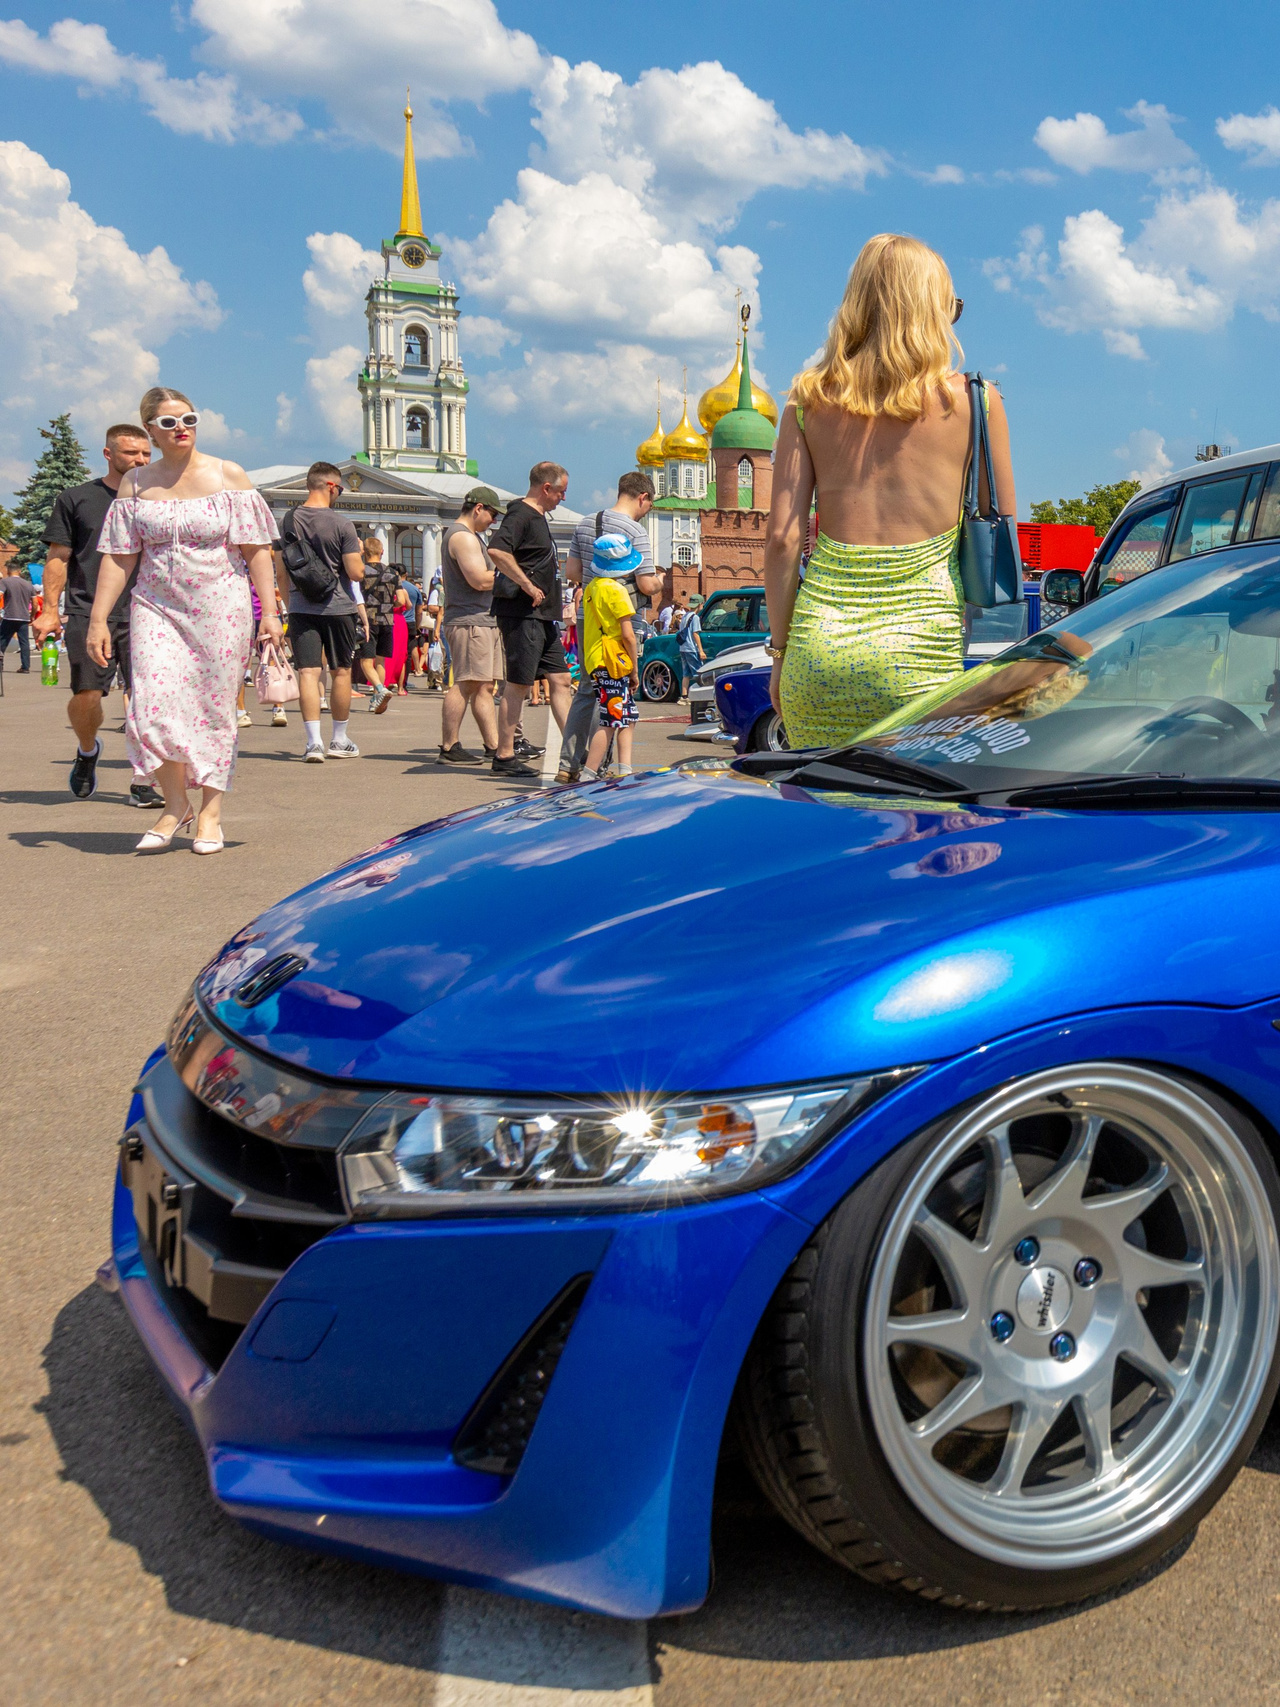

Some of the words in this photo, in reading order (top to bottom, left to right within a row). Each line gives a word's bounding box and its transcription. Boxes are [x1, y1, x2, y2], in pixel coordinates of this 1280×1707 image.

[895, 714, 990, 741] UNDER
[970, 717, 1031, 755] HOOD
[1037, 1271, 1056, 1327] whistler
